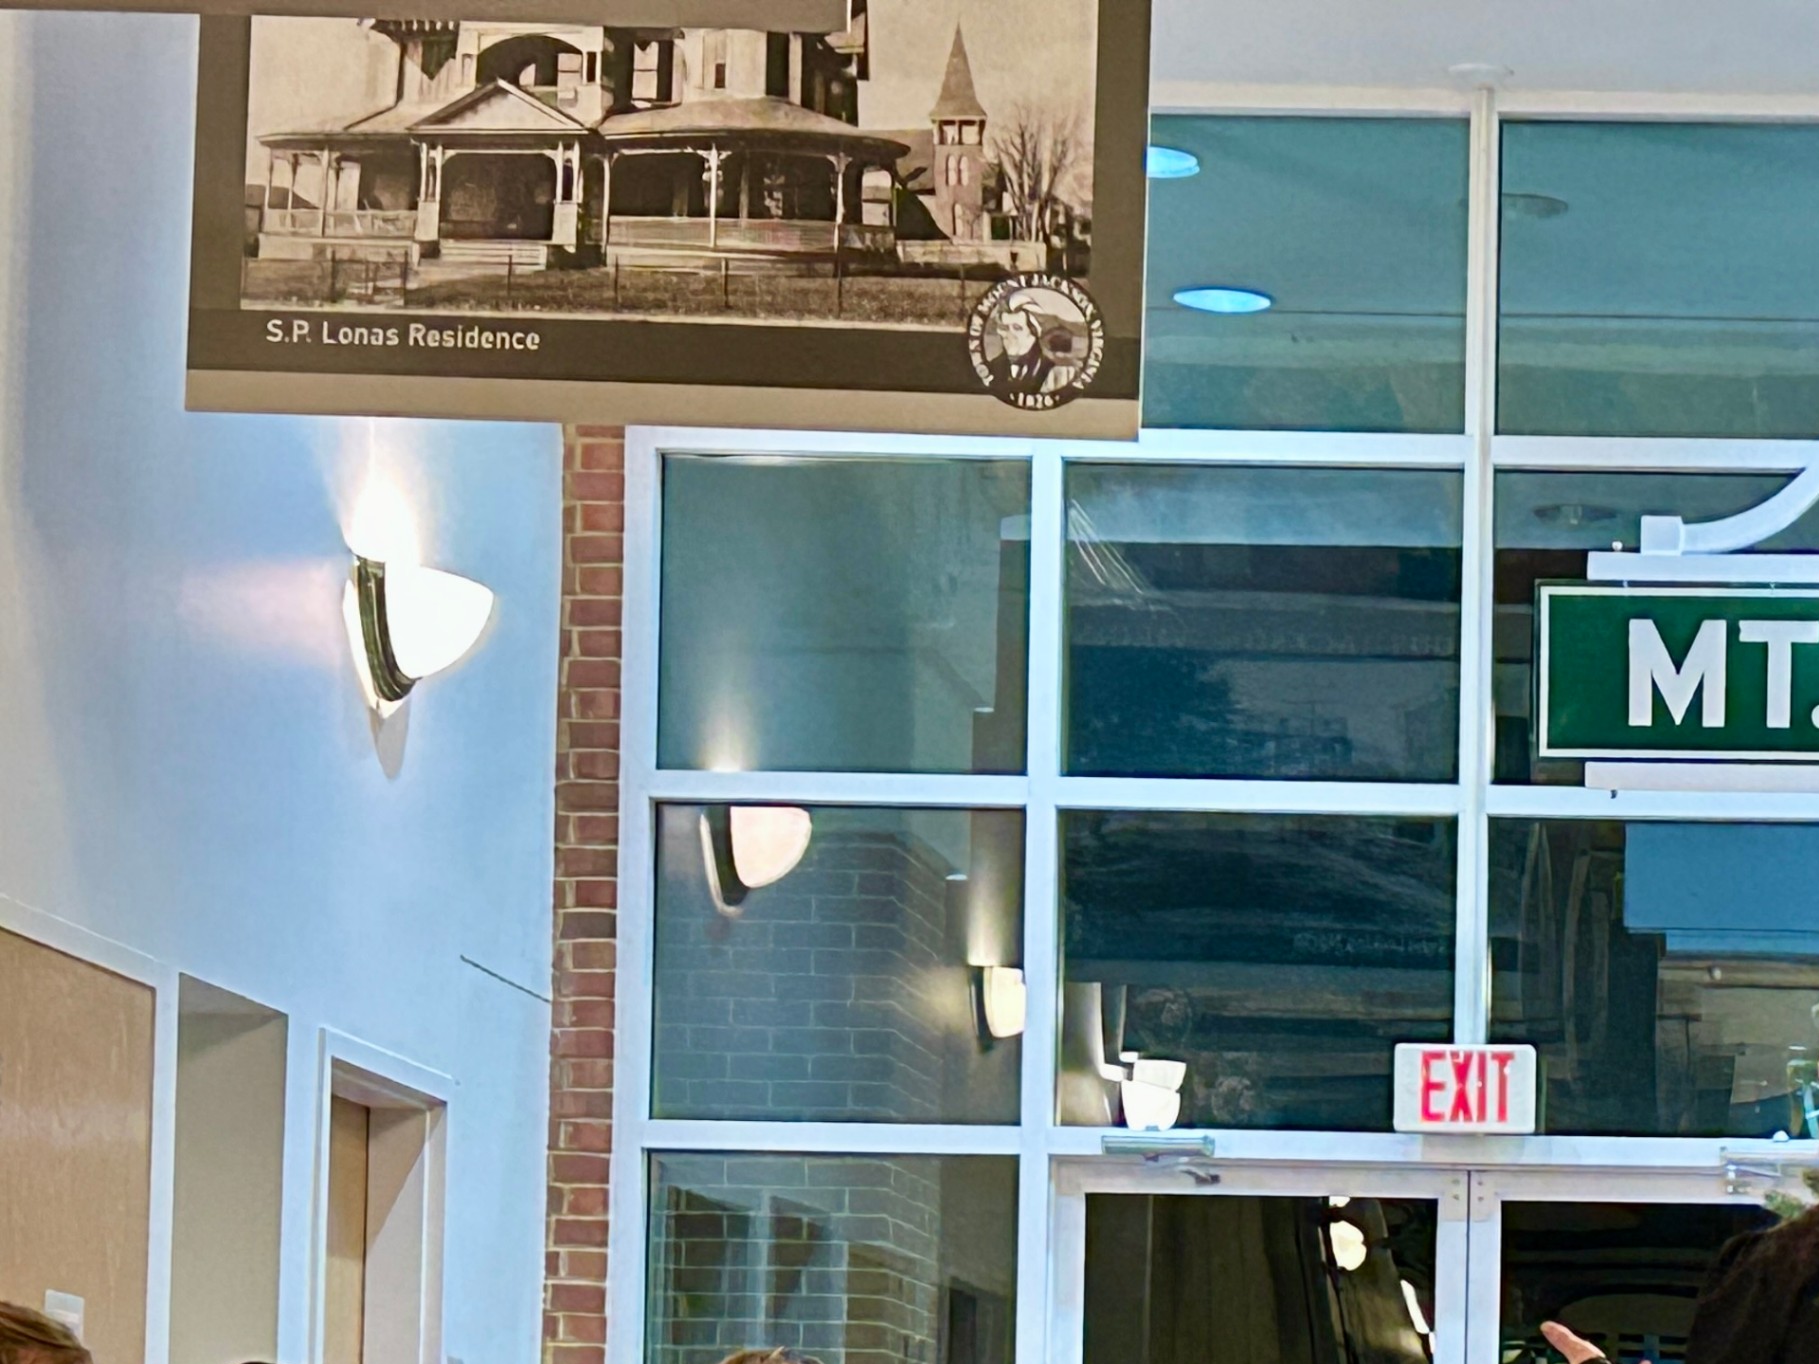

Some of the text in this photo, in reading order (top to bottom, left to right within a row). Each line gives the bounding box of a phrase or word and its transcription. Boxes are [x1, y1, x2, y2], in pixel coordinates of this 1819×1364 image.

[265, 318, 541, 351] S.P. Lonas Residence
[1420, 1051, 1516, 1123] EXIT
